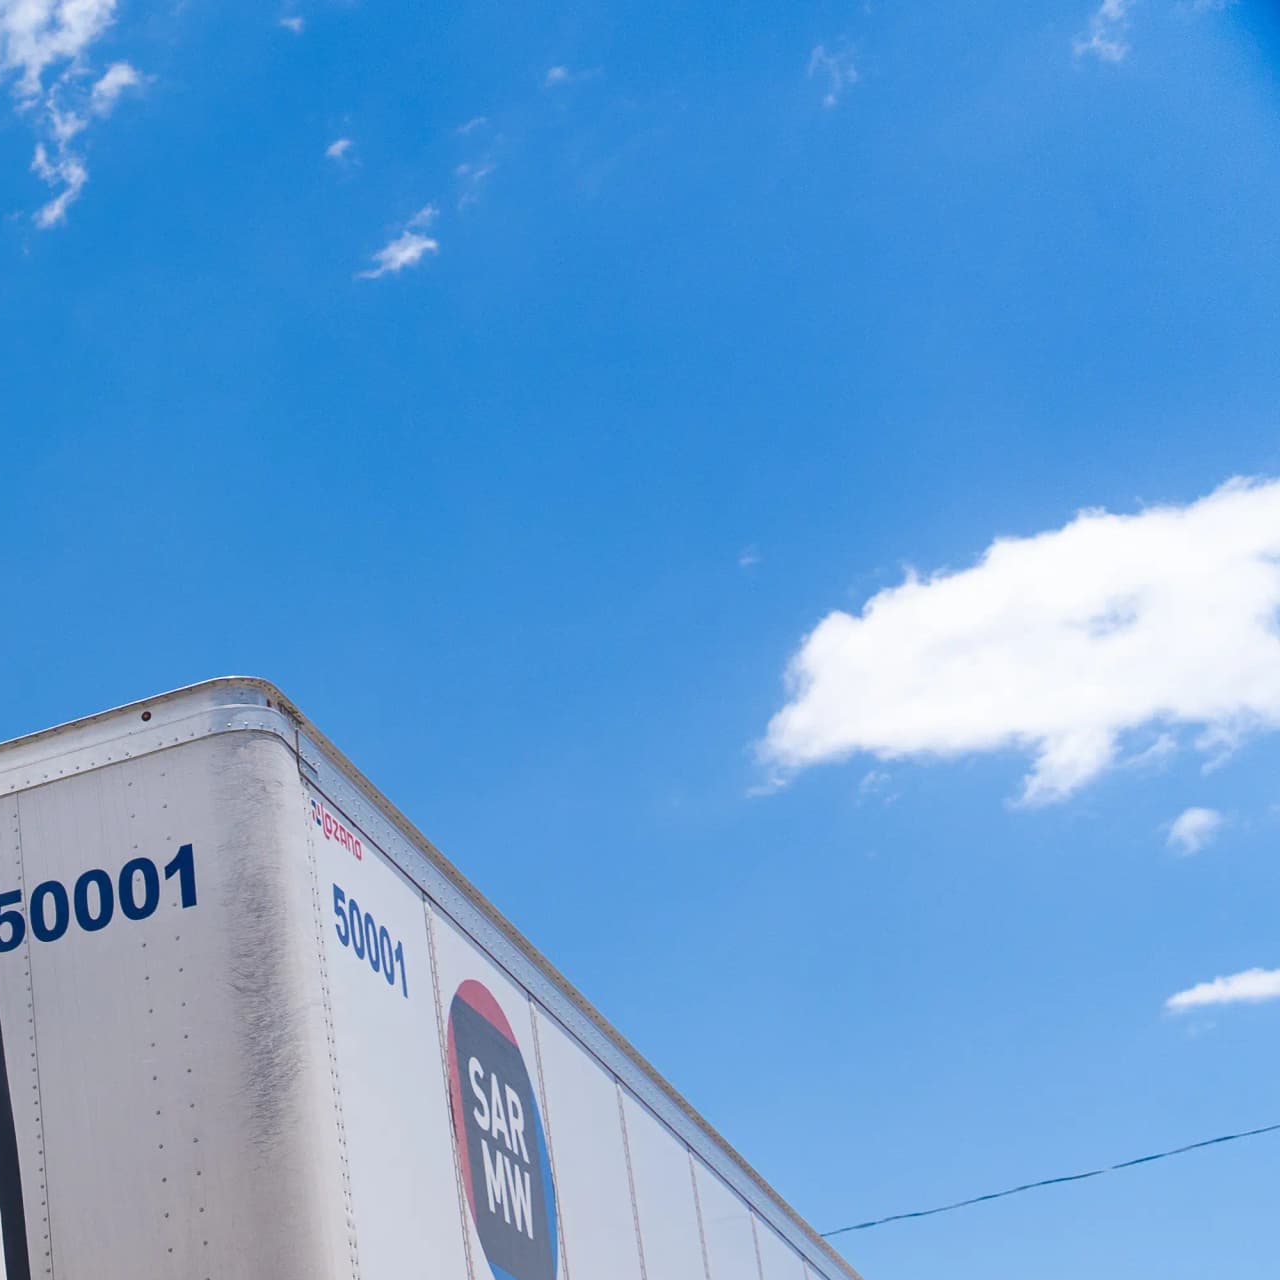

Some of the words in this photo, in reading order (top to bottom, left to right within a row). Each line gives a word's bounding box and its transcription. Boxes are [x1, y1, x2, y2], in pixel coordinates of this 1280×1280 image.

[332, 883, 408, 998] 50001
[469, 1056, 530, 1164] SAR
[481, 1139, 533, 1240] MW
